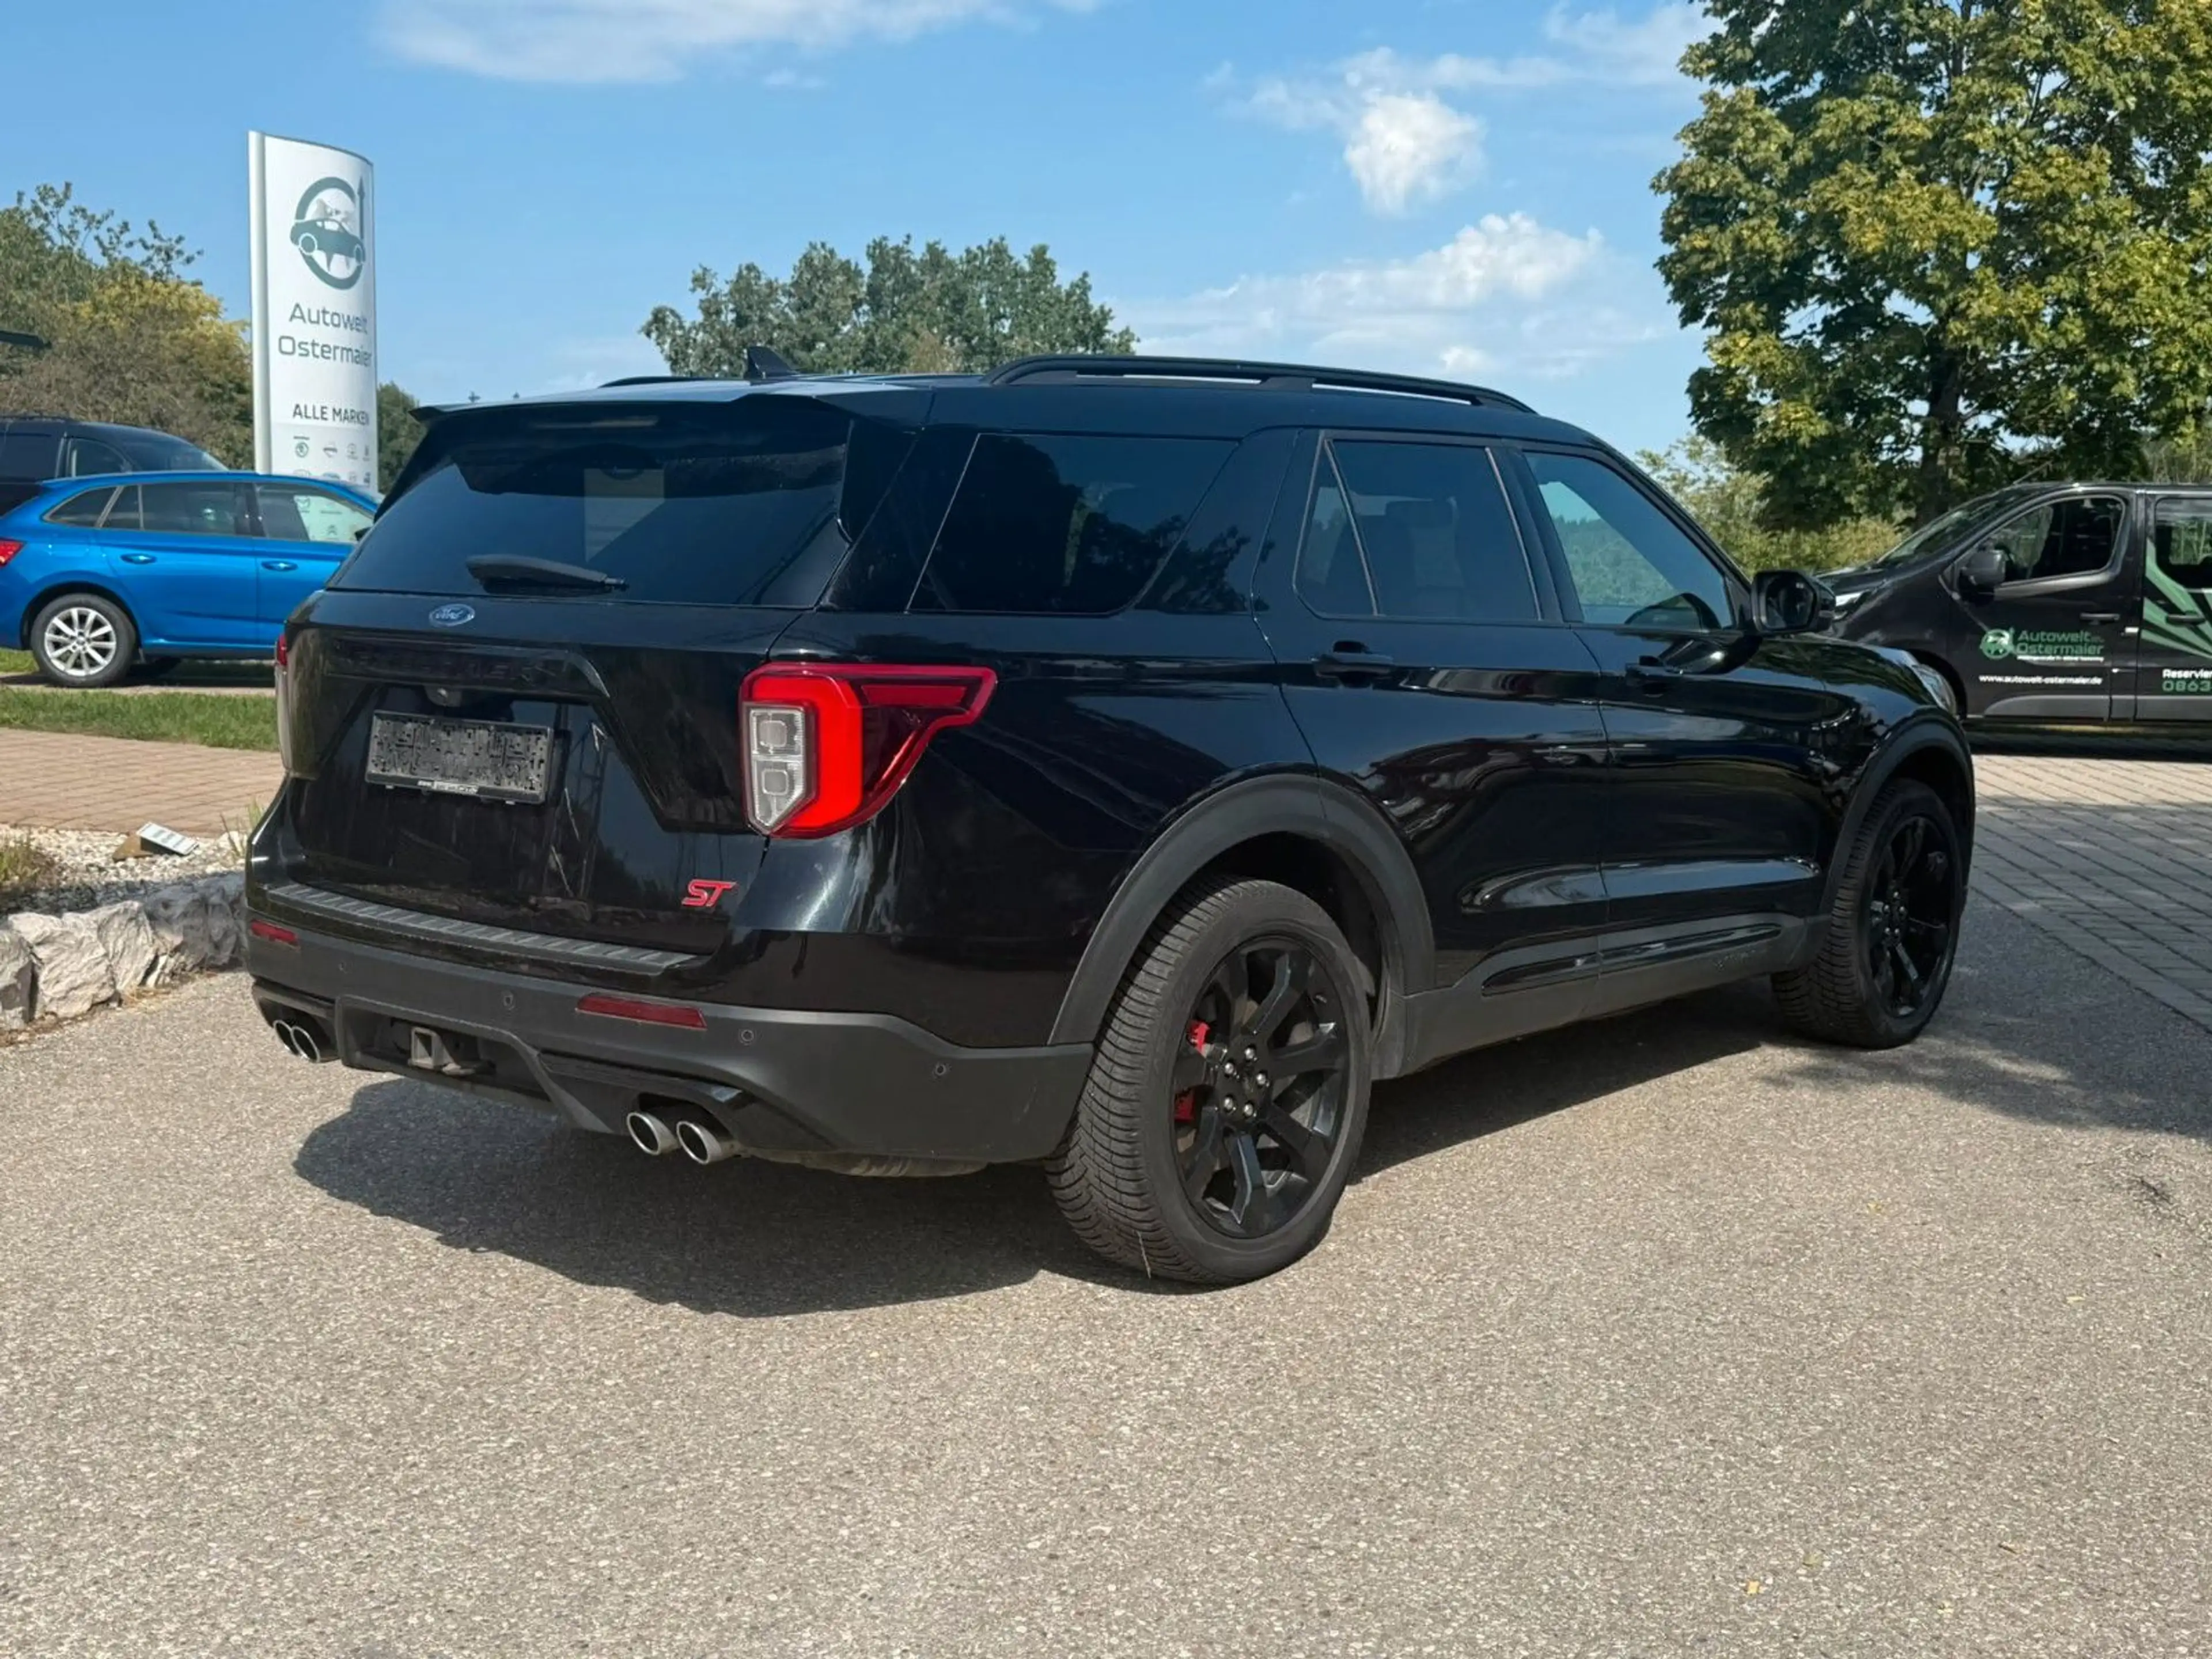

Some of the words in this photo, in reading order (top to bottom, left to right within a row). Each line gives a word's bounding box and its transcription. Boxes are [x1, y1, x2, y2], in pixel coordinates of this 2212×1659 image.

[278, 335, 372, 367] Ostermaier
[292, 404, 328, 421] ALLE
[332, 407, 370, 426] MARKEN
[2018, 630, 2092, 642] Autowelt
[2017, 642, 2104, 654] Ostermaier
[2162, 680, 2212, 692] 0863
[681, 879, 737, 907] ST
